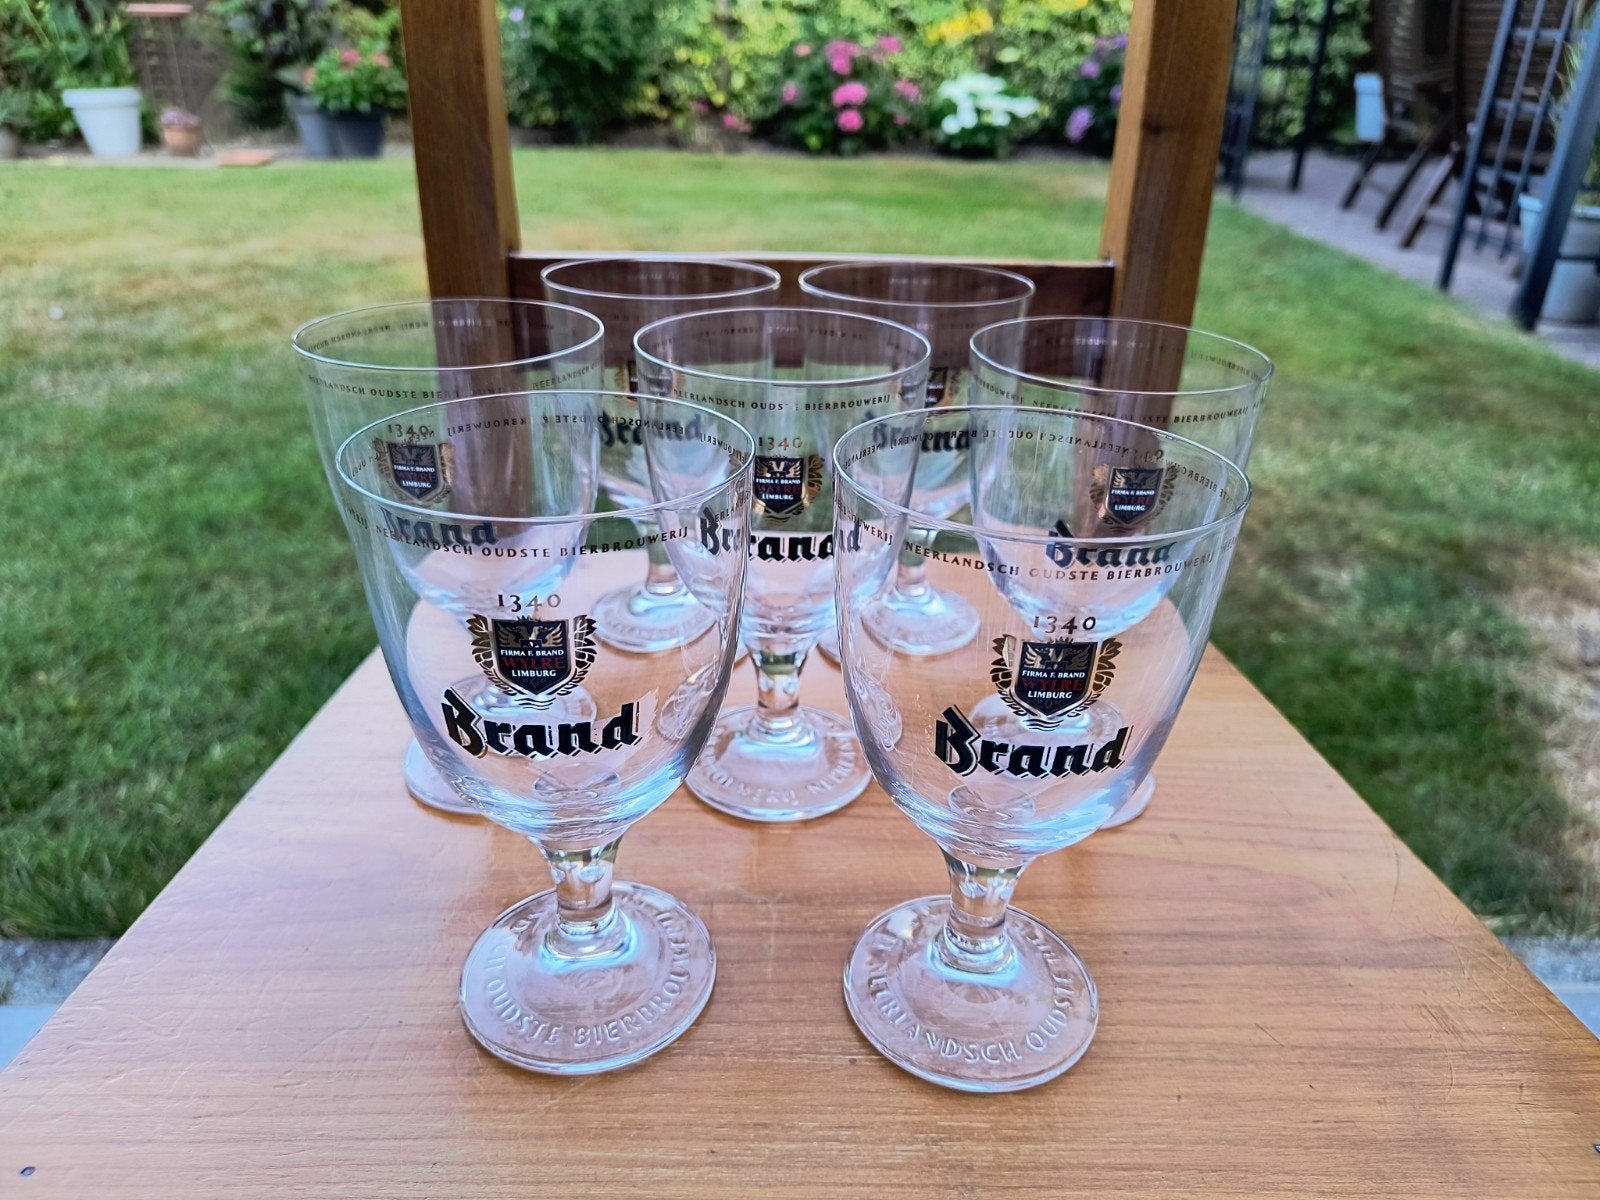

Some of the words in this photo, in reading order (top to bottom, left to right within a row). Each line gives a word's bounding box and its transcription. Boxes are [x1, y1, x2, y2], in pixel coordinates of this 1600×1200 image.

[370, 388, 417, 399] OUDSTE
[804, 394, 891, 412] BIERBROUWERIJ
[758, 436, 803, 451] 1340
[481, 546, 551, 559] OUDSTE
[560, 526, 689, 557] BIERBROUWERIJ
[905, 541, 1020, 576] NEERLANDSCH
[1029, 567, 1099, 581] OUDSTE
[1106, 551, 1215, 581] BIERBROUWERIJ
[497, 593, 562, 613] 1340
[1033, 615, 1096, 635] 1340
[500, 649, 526, 657] FIRMA
[535, 649, 565, 657] BRAND
[503, 657, 566, 669] WYLRE
[511, 669, 557, 677] LIMBURG
[1021, 669, 1048, 678] FIRMA
[1058, 671, 1086, 679] BRAND
[1028, 690, 1073, 699] LIMBURG
[440, 686, 643, 760] Brand
[934, 704, 1133, 778] Brand
